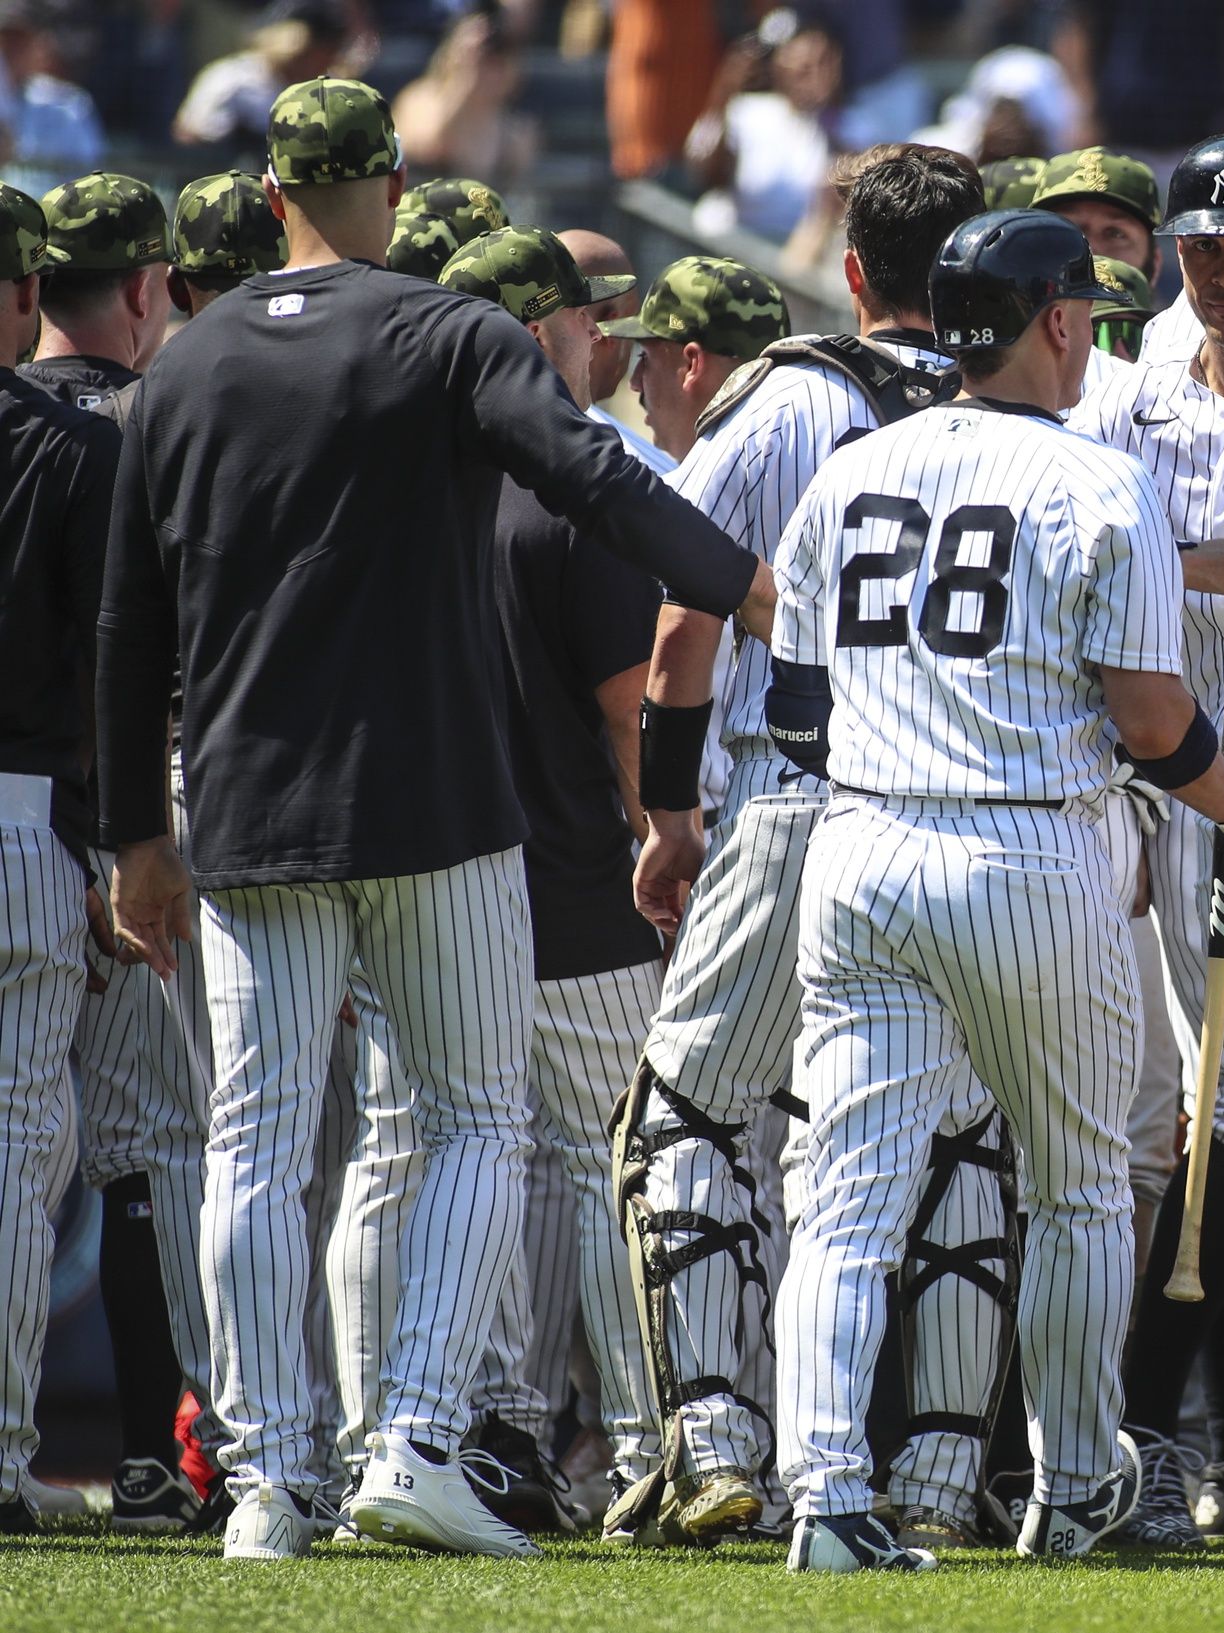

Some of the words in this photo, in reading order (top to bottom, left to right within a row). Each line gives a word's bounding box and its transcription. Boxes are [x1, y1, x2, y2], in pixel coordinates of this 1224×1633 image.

[970, 327, 994, 345] 28
[836, 492, 1017, 659] 28
[769, 723, 819, 742] marucci
[394, 1472, 415, 1490] 13
[229, 1528, 241, 1546] 13
[1050, 1528, 1076, 1553] 28
